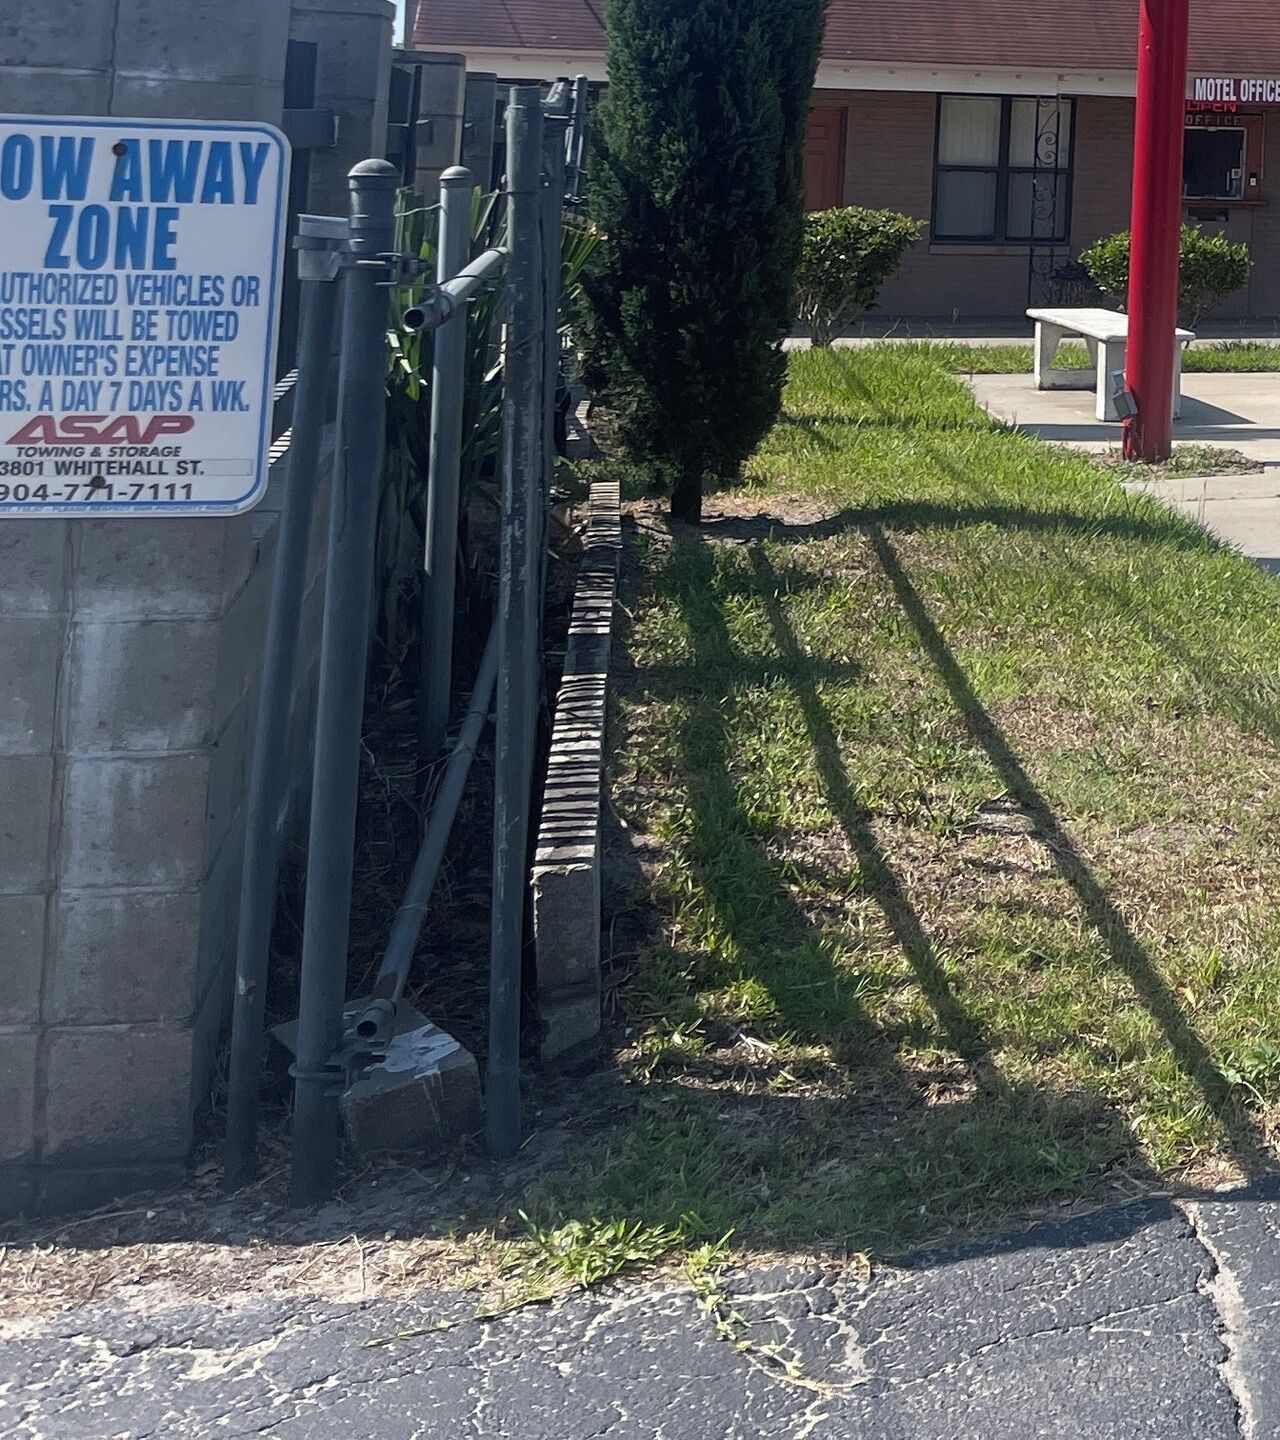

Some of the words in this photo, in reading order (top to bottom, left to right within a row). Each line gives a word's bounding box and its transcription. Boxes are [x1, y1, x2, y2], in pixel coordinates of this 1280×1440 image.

[1195, 78, 1237, 101] MOTEL
[1185, 114, 1241, 126] OFFICE
[109, 138, 271, 205] AWAY
[44, 204, 180, 271] ZONE
[126, 274, 225, 307] VEHICLES
[231, 275, 260, 307] OR
[74, 310, 124, 340] WILL
[131, 310, 158, 341] BE
[166, 311, 239, 342] TOWED
[21, 344, 118, 377] OWNER'S
[125, 345, 220, 377] EXPENSE
[39, 380, 54, 412] A
[61, 380, 106, 412] DAY
[109, 381, 123, 412] 7
[128, 381, 183, 413] DAYS
[187, 381, 204, 412] A
[211, 381, 250, 413] WK.
[5, 415, 195, 445] ASAP
[17, 446, 85, 457] TOWING
[90, 446, 102, 457] &
[108, 446, 182, 457] STORAGE
[0, 461, 44, 475] 3801
[54, 461, 167, 476] WHITEHALL
[175, 461, 205, 476] ST.
[0, 483, 193, 501] 904-771-7111
